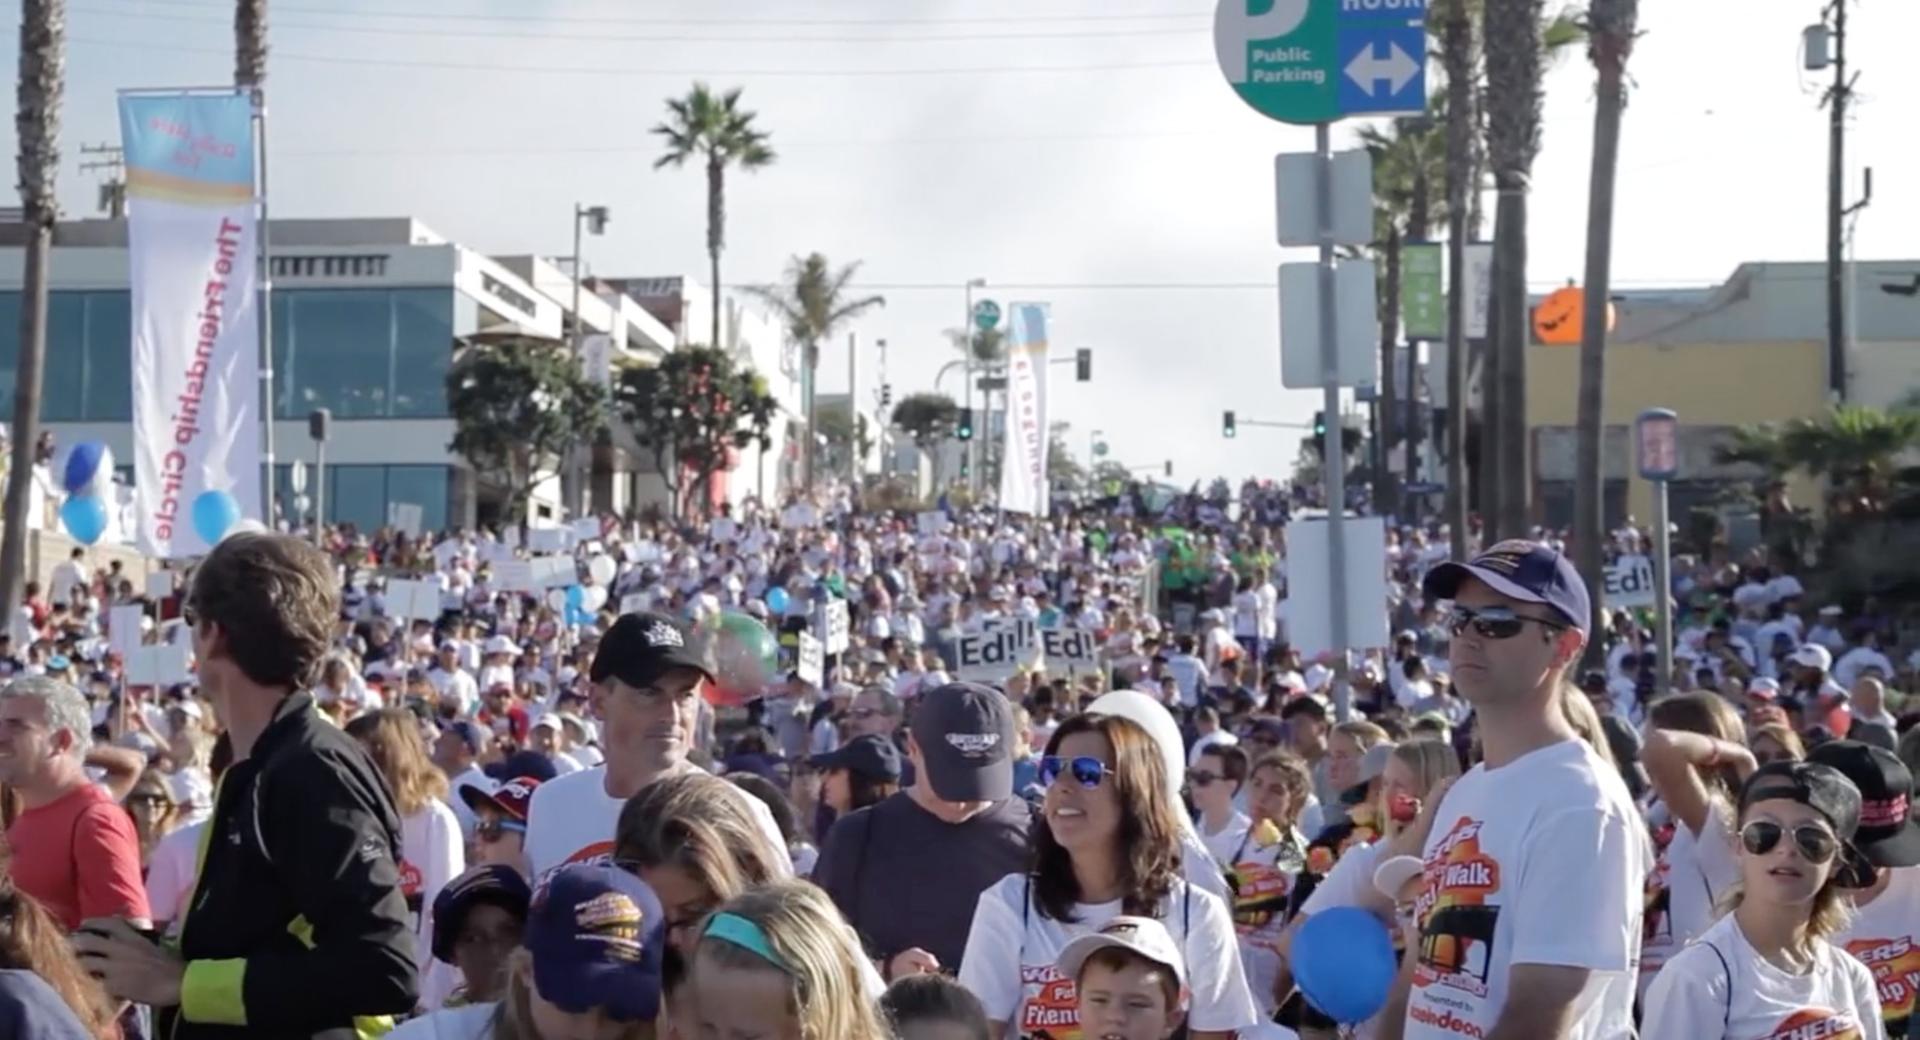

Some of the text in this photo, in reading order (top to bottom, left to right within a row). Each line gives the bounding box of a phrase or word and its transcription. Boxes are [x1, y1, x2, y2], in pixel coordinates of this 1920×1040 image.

[1253, 47, 1311, 63] Public
[1253, 67, 1326, 84] Parking
[1604, 566, 1651, 594] Ed!
[961, 632, 1016, 666] Ed!
[1044, 630, 1094, 661] Ed!
[1446, 861, 1491, 887] Walk
